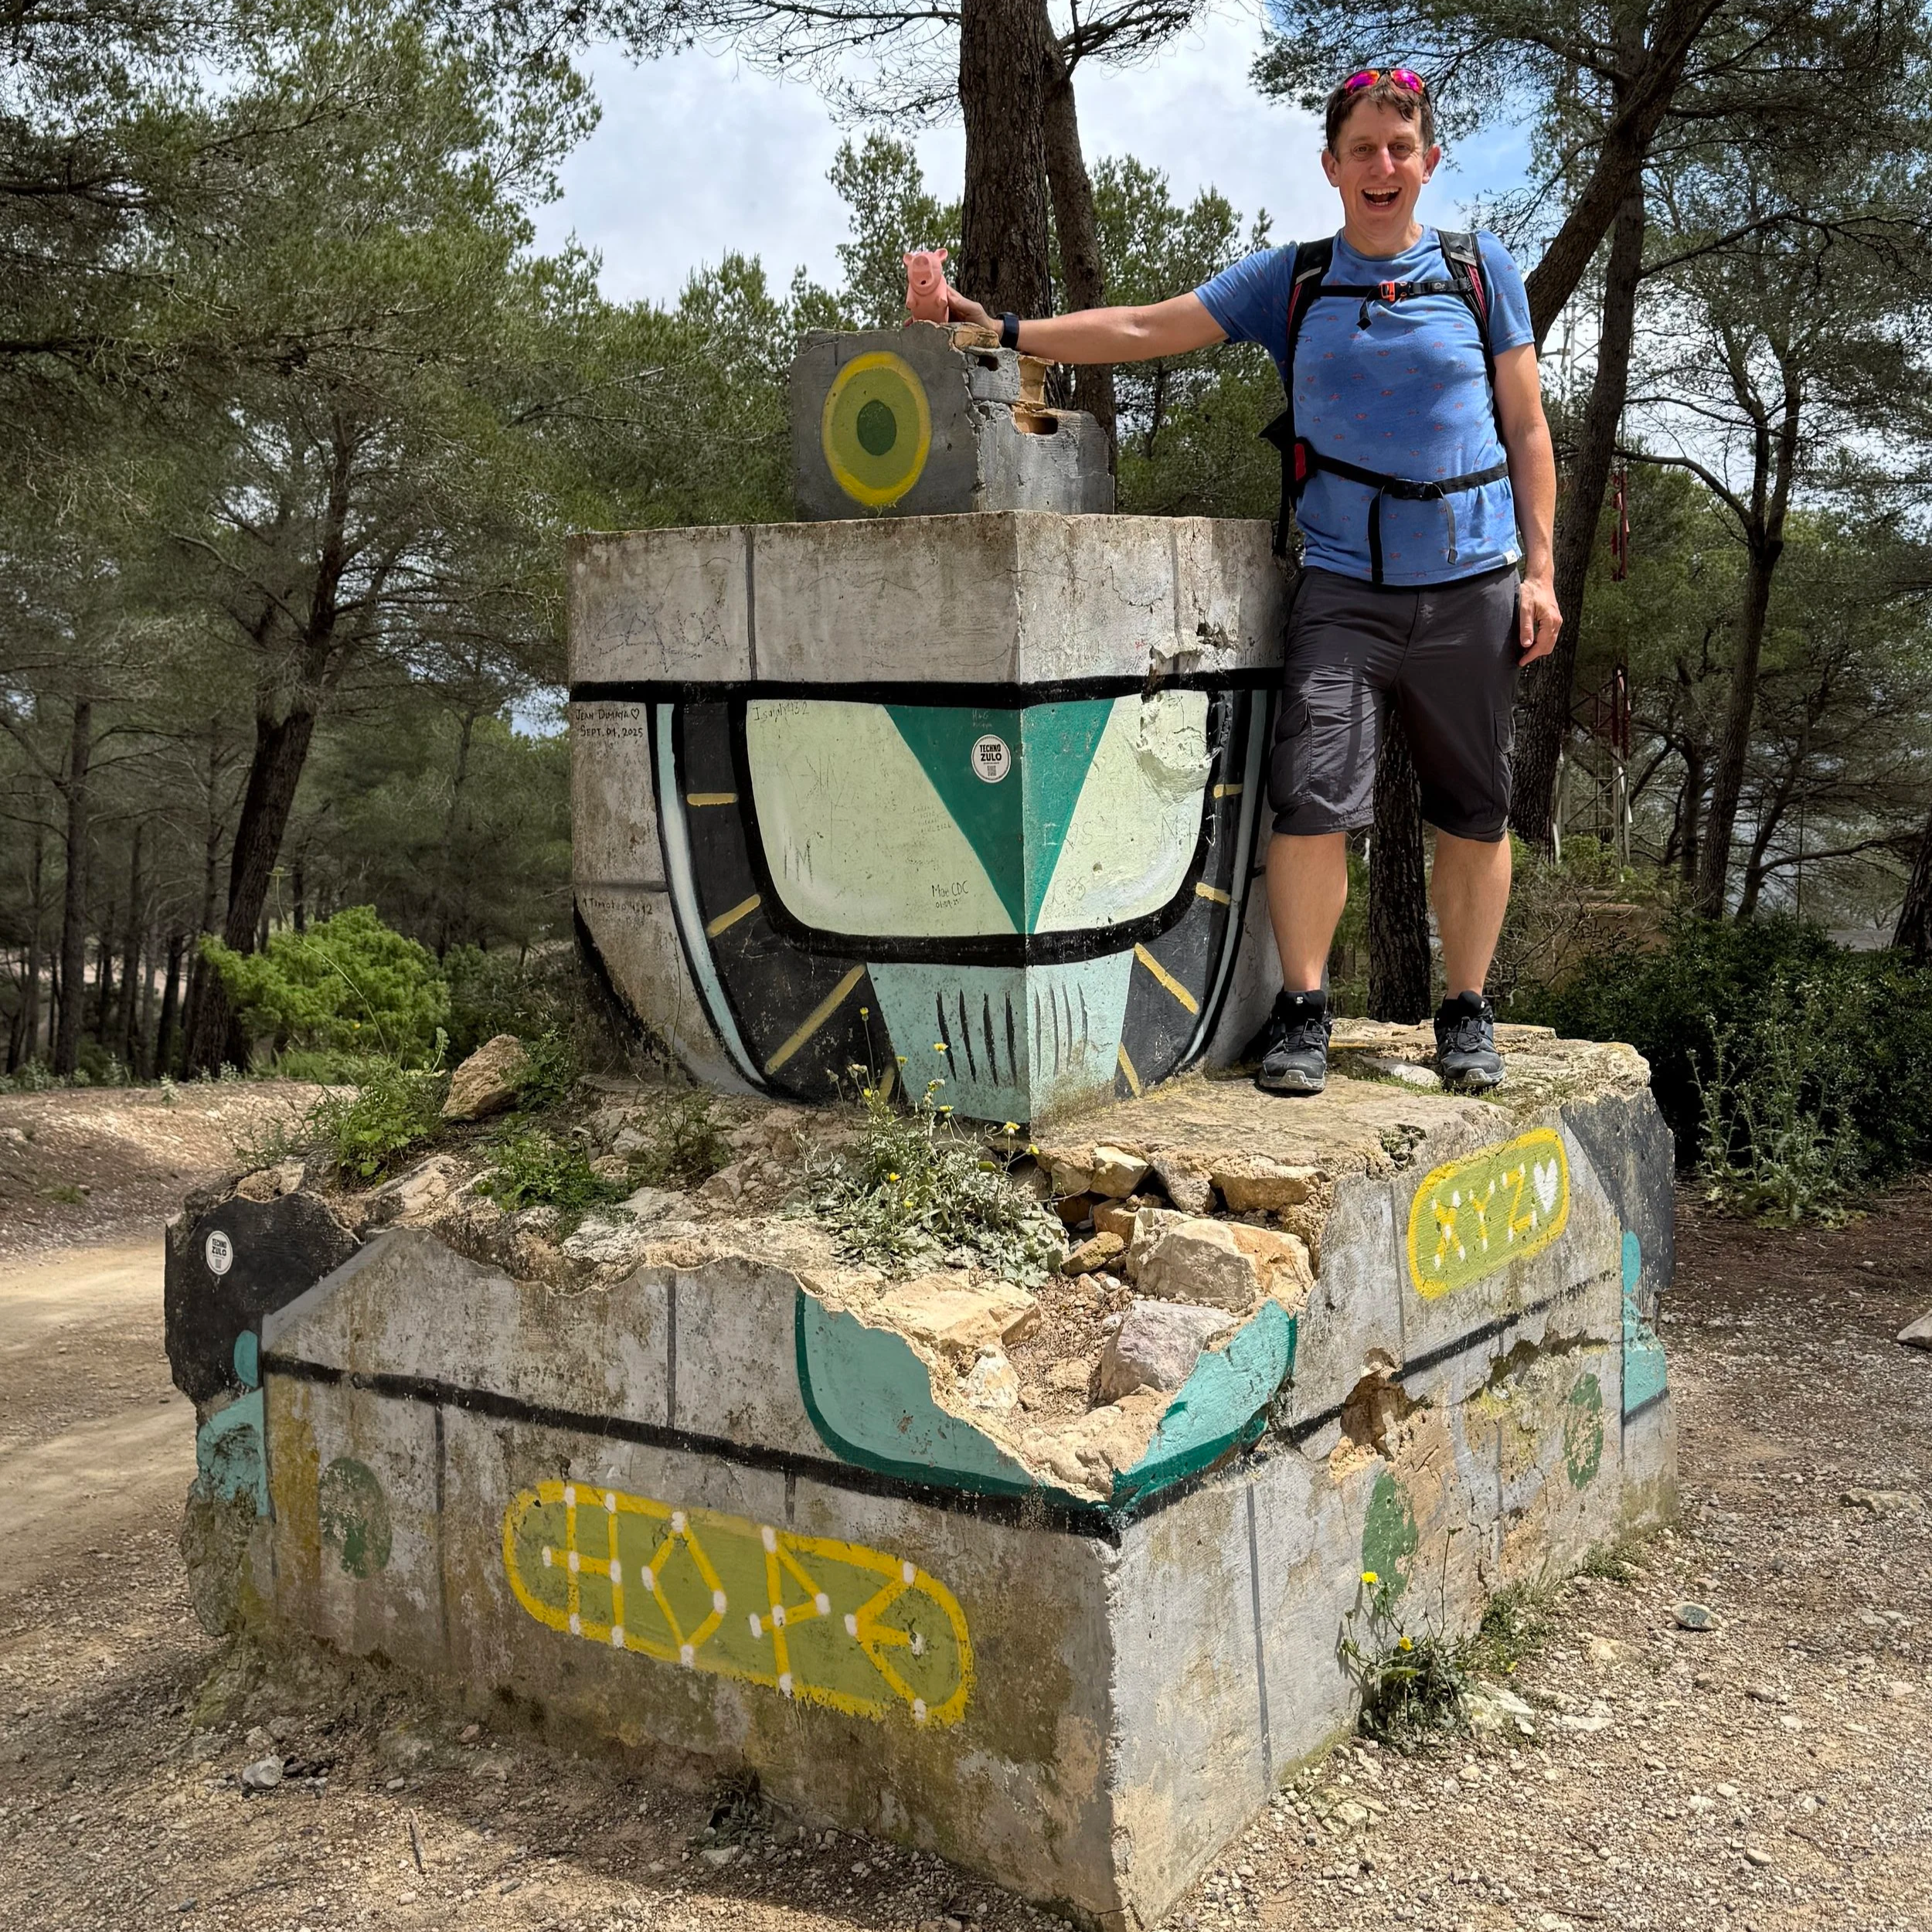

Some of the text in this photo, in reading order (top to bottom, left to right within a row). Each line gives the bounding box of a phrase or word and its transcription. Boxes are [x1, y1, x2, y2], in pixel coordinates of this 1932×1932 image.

[621, 727, 643, 738] 2025
[979, 743, 1002, 753] TECHNO
[980, 753, 1002, 762] ZULO
[1431, 1162, 1538, 1270] XYZ
[211, 1246, 227, 1257] ZULO
[543, 1486, 927, 1722] HOPE
